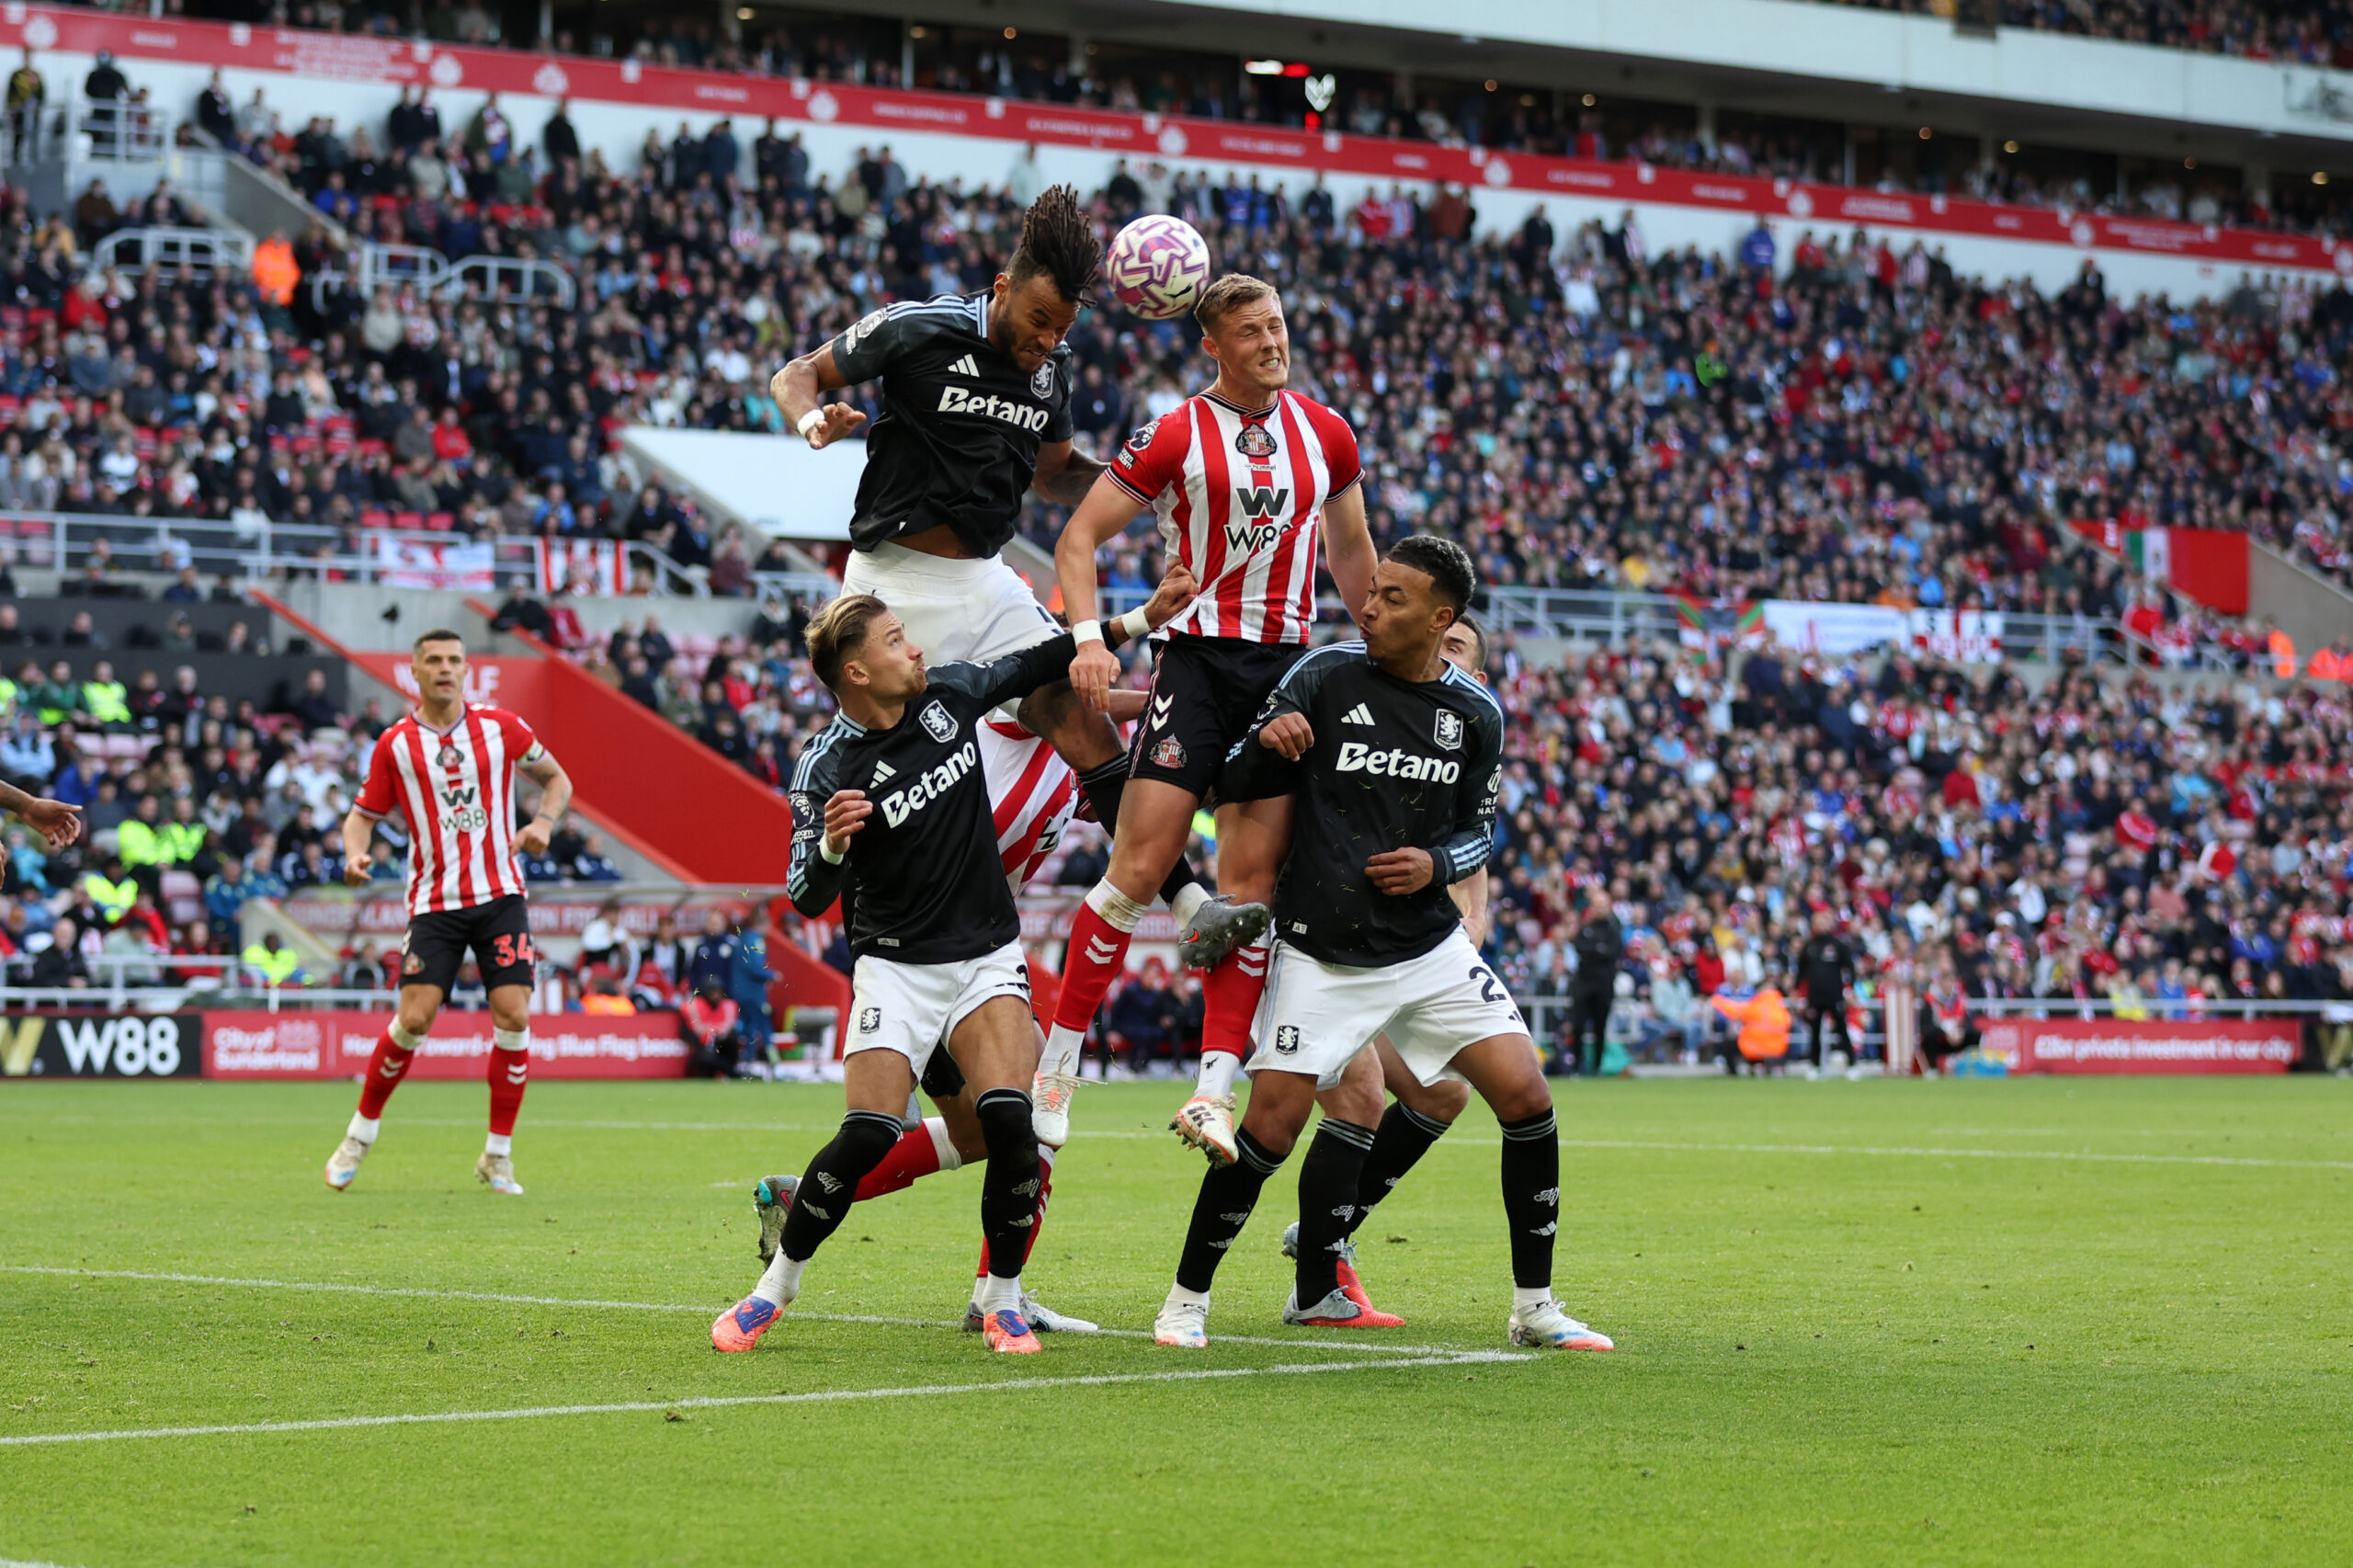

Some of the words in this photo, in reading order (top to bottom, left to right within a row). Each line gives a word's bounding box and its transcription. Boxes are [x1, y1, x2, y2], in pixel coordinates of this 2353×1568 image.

[937, 385, 1050, 433] Betano
[1236, 488, 1290, 517] W
[1225, 524, 1291, 553] W8
[1335, 742, 1461, 785] Betano
[881, 742, 976, 829] Betano
[439, 809, 486, 831] W88
[493, 932, 535, 968] 34
[56, 1016, 181, 1076] W88
